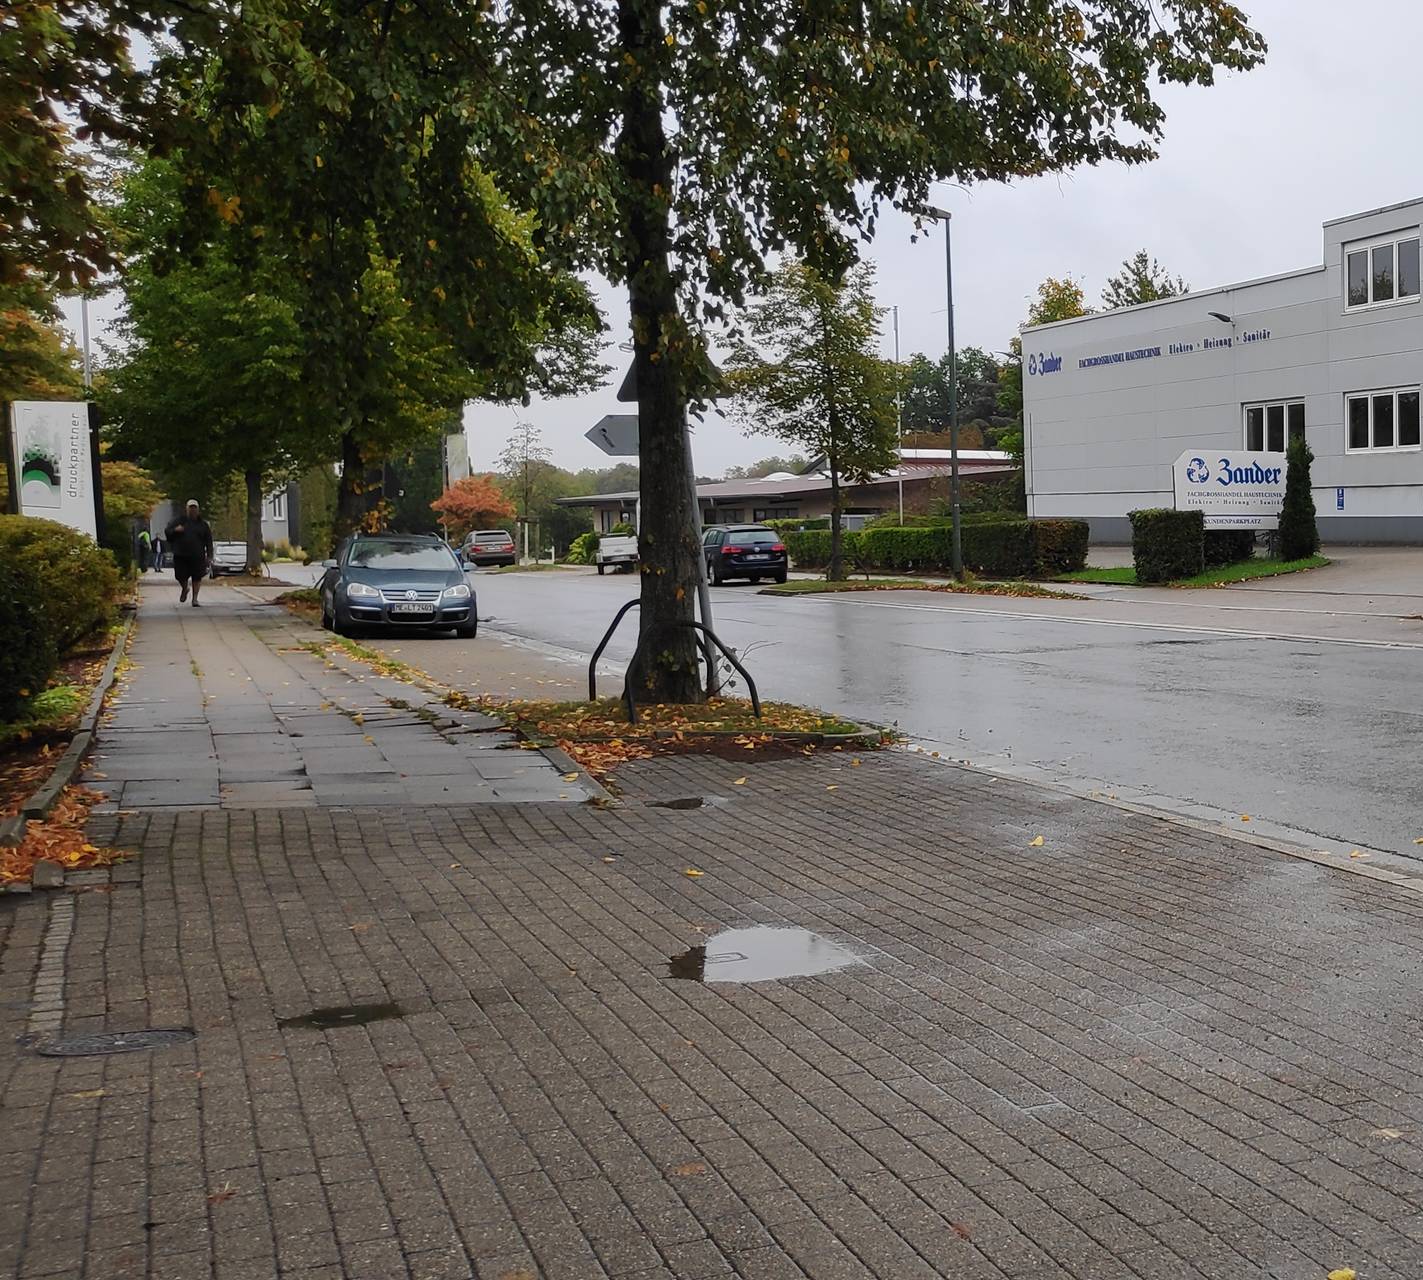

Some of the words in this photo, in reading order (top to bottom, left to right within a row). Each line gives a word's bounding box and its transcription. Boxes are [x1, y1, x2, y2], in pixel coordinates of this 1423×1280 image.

[1038, 352, 1062, 376] Zander
[1078, 352, 1124, 369] FACHGROSSHANDEL
[1125, 346, 1161, 361] HAUSTECHNIK
[1169, 342, 1194, 354] Elektro
[1203, 337, 1232, 349] Heizung
[1243, 329, 1271, 343] Sanitär
[66, 412, 80, 498] druckpartner
[1216, 459, 1282, 486] Zander
